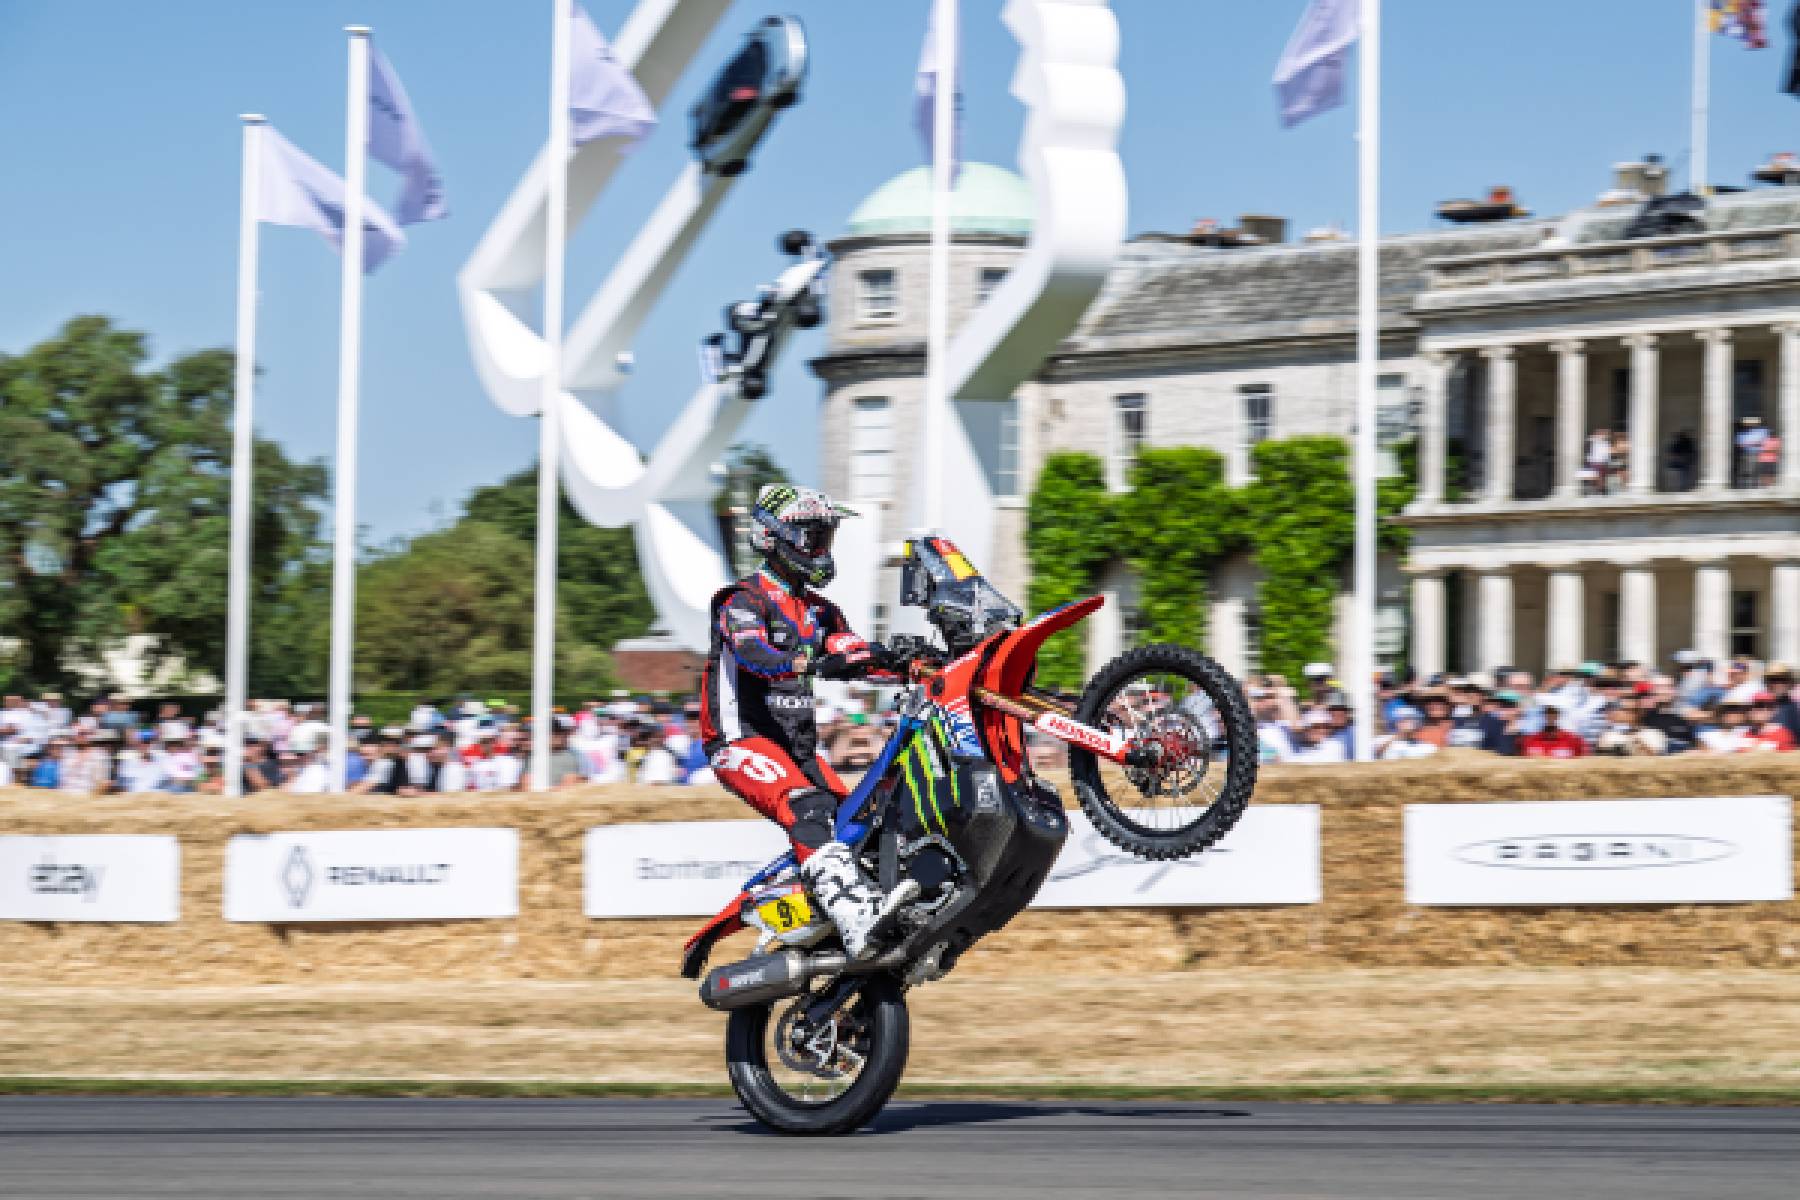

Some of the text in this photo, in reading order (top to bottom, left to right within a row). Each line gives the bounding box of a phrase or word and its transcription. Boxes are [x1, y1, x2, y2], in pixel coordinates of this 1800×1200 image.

[1048, 717, 1112, 751] HONDA
[326, 863, 451, 885] RENAULT
[776, 899, 793, 928] 9
